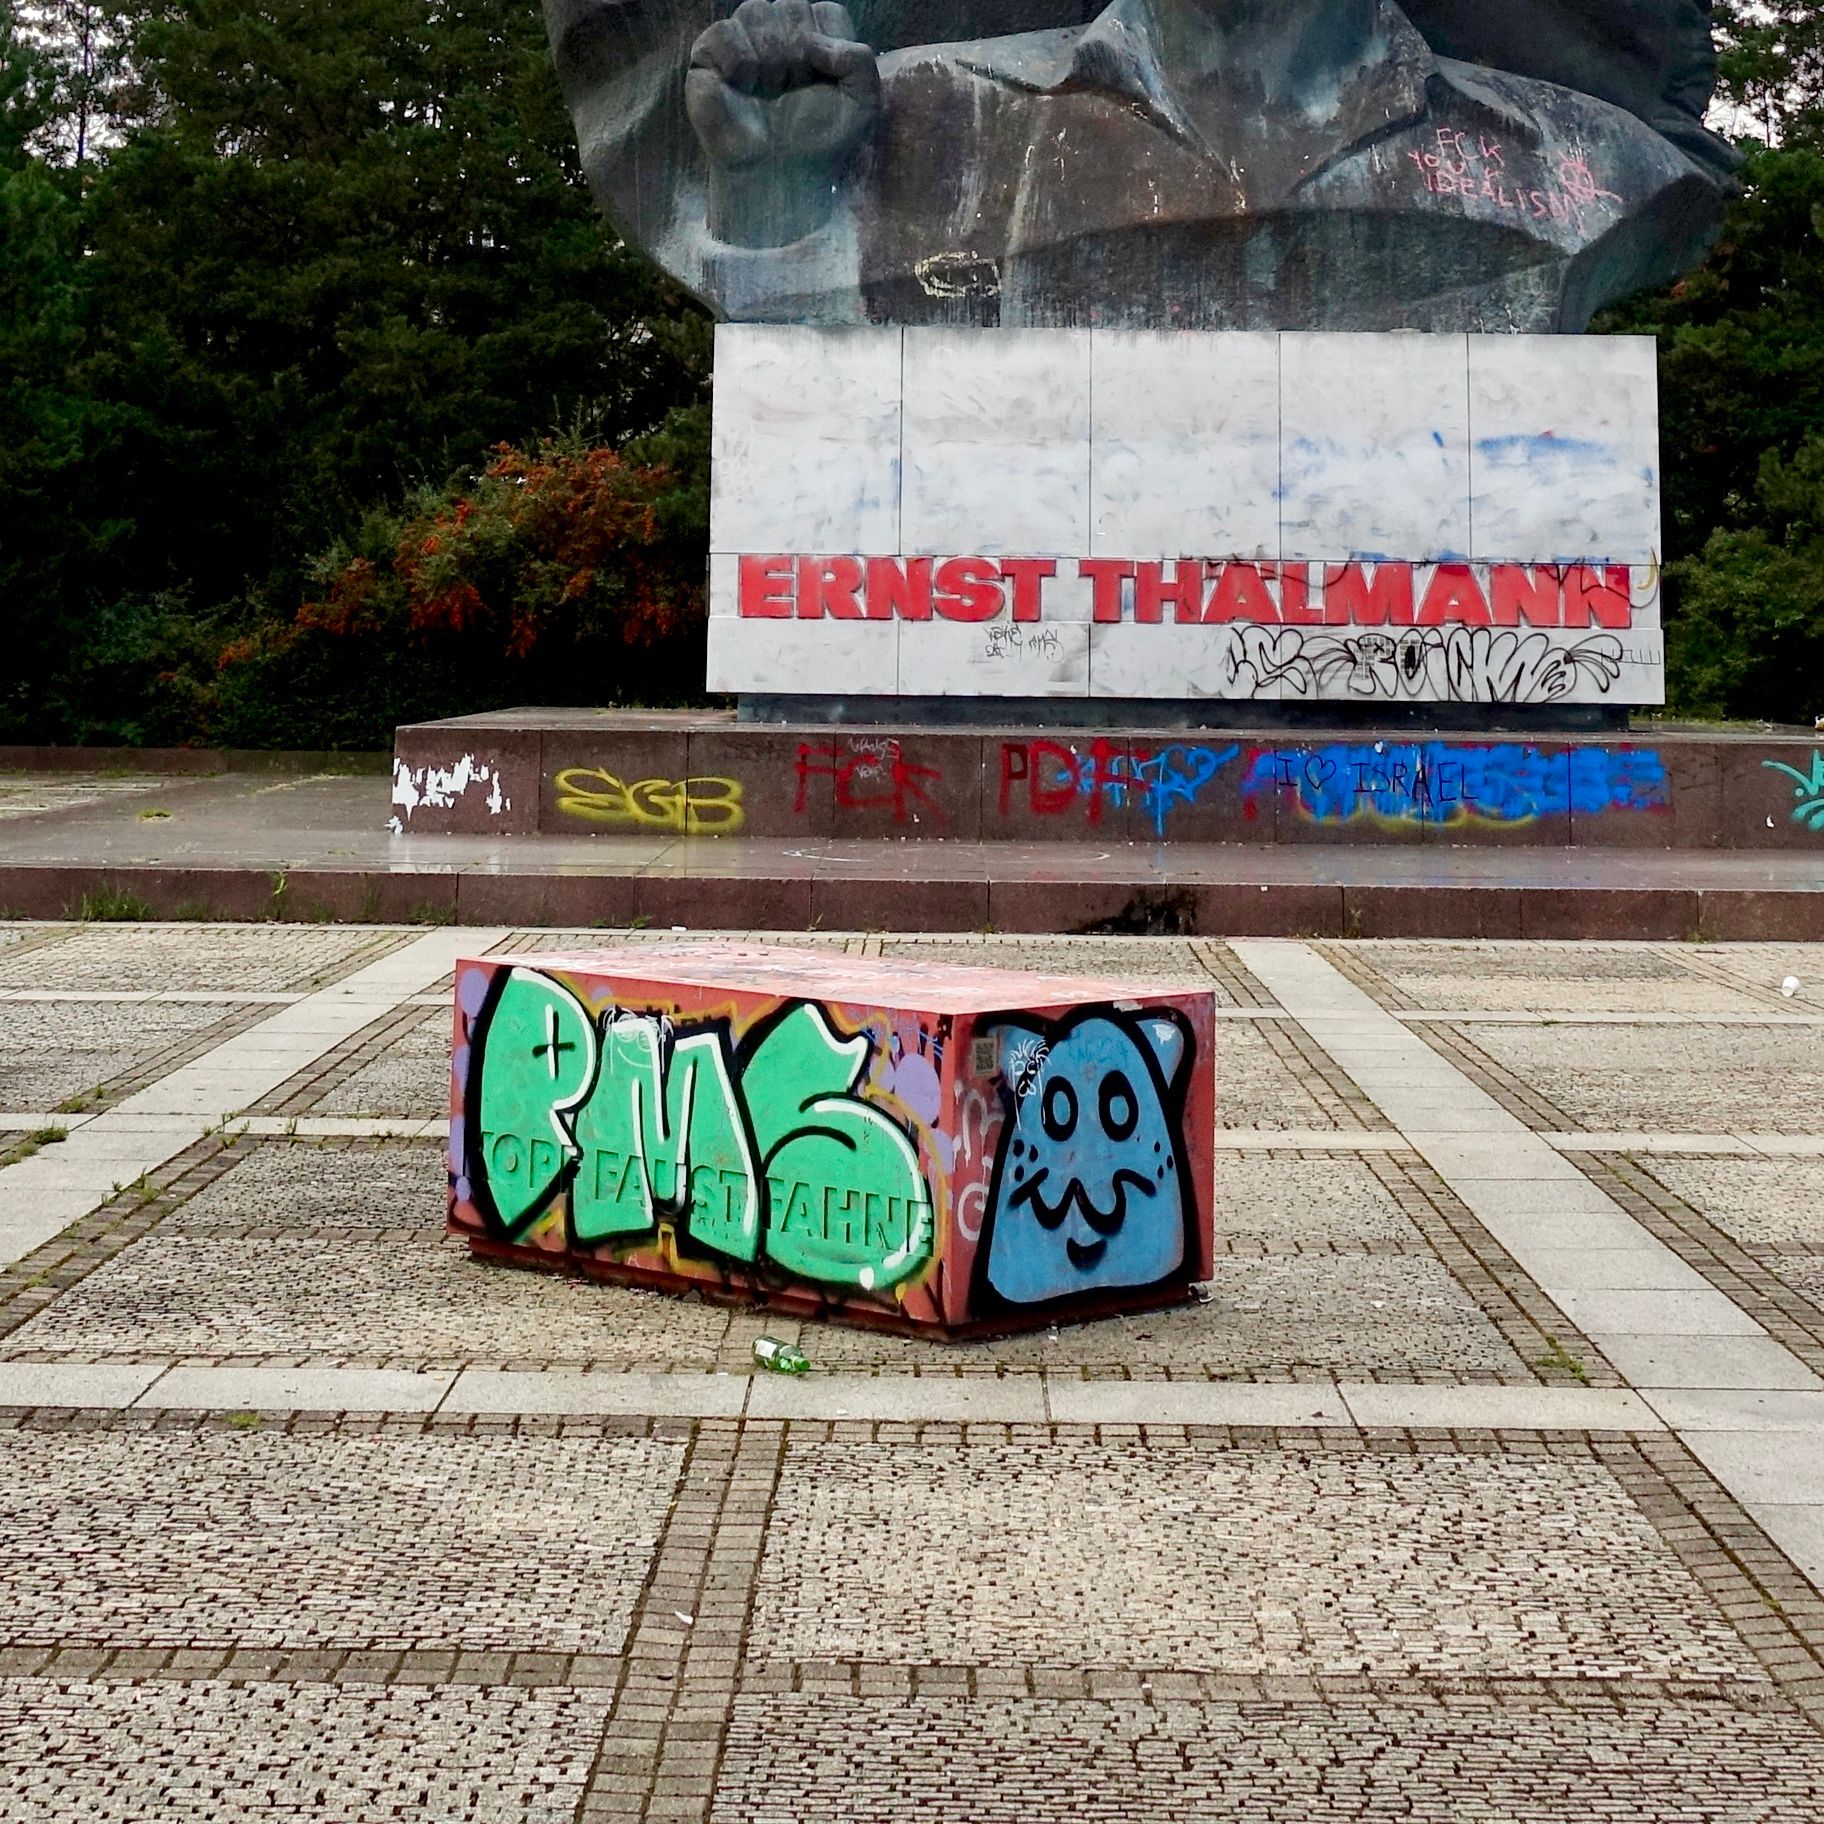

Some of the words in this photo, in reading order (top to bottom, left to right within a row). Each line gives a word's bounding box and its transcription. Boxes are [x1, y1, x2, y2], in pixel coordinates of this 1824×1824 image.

[738, 554, 1057, 623] ERNST
[1078, 558, 1632, 629] THÄLMANN
[1349, 760, 1480, 805] ISRAEL
[594, 1148, 753, 1223] FAUST
[763, 1175, 936, 1258] FAHNE
